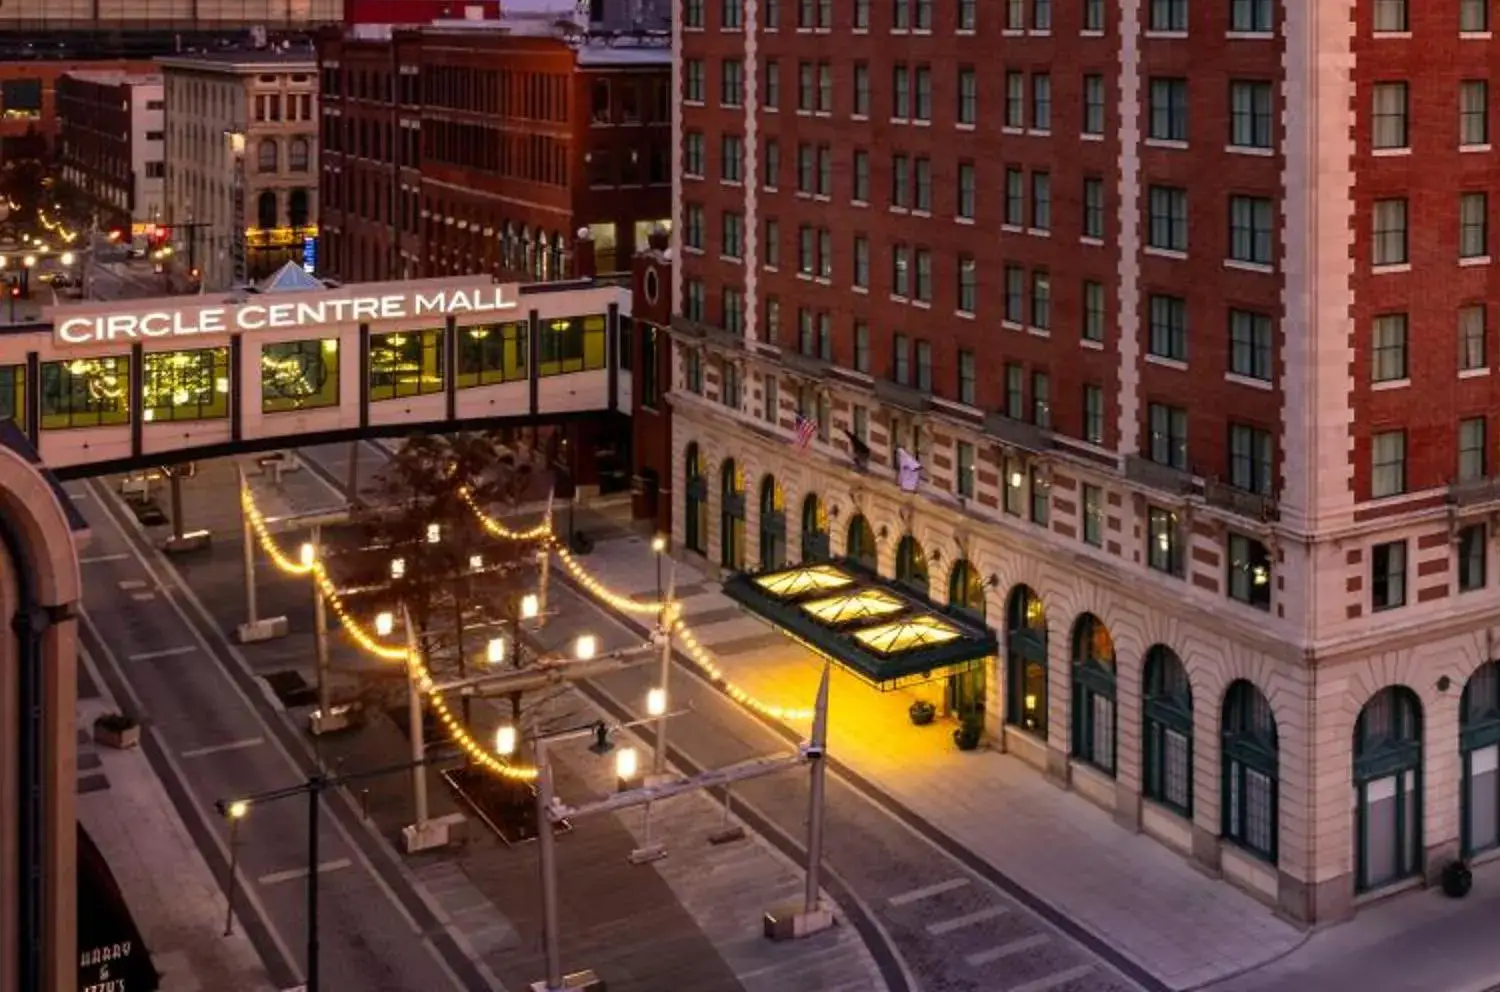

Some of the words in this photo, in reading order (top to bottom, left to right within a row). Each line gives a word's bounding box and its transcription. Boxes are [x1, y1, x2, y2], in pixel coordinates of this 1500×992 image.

[60, 310, 226, 342] CIRCLE
[236, 296, 405, 329] CENTRE
[415, 288, 517, 315] MALL
